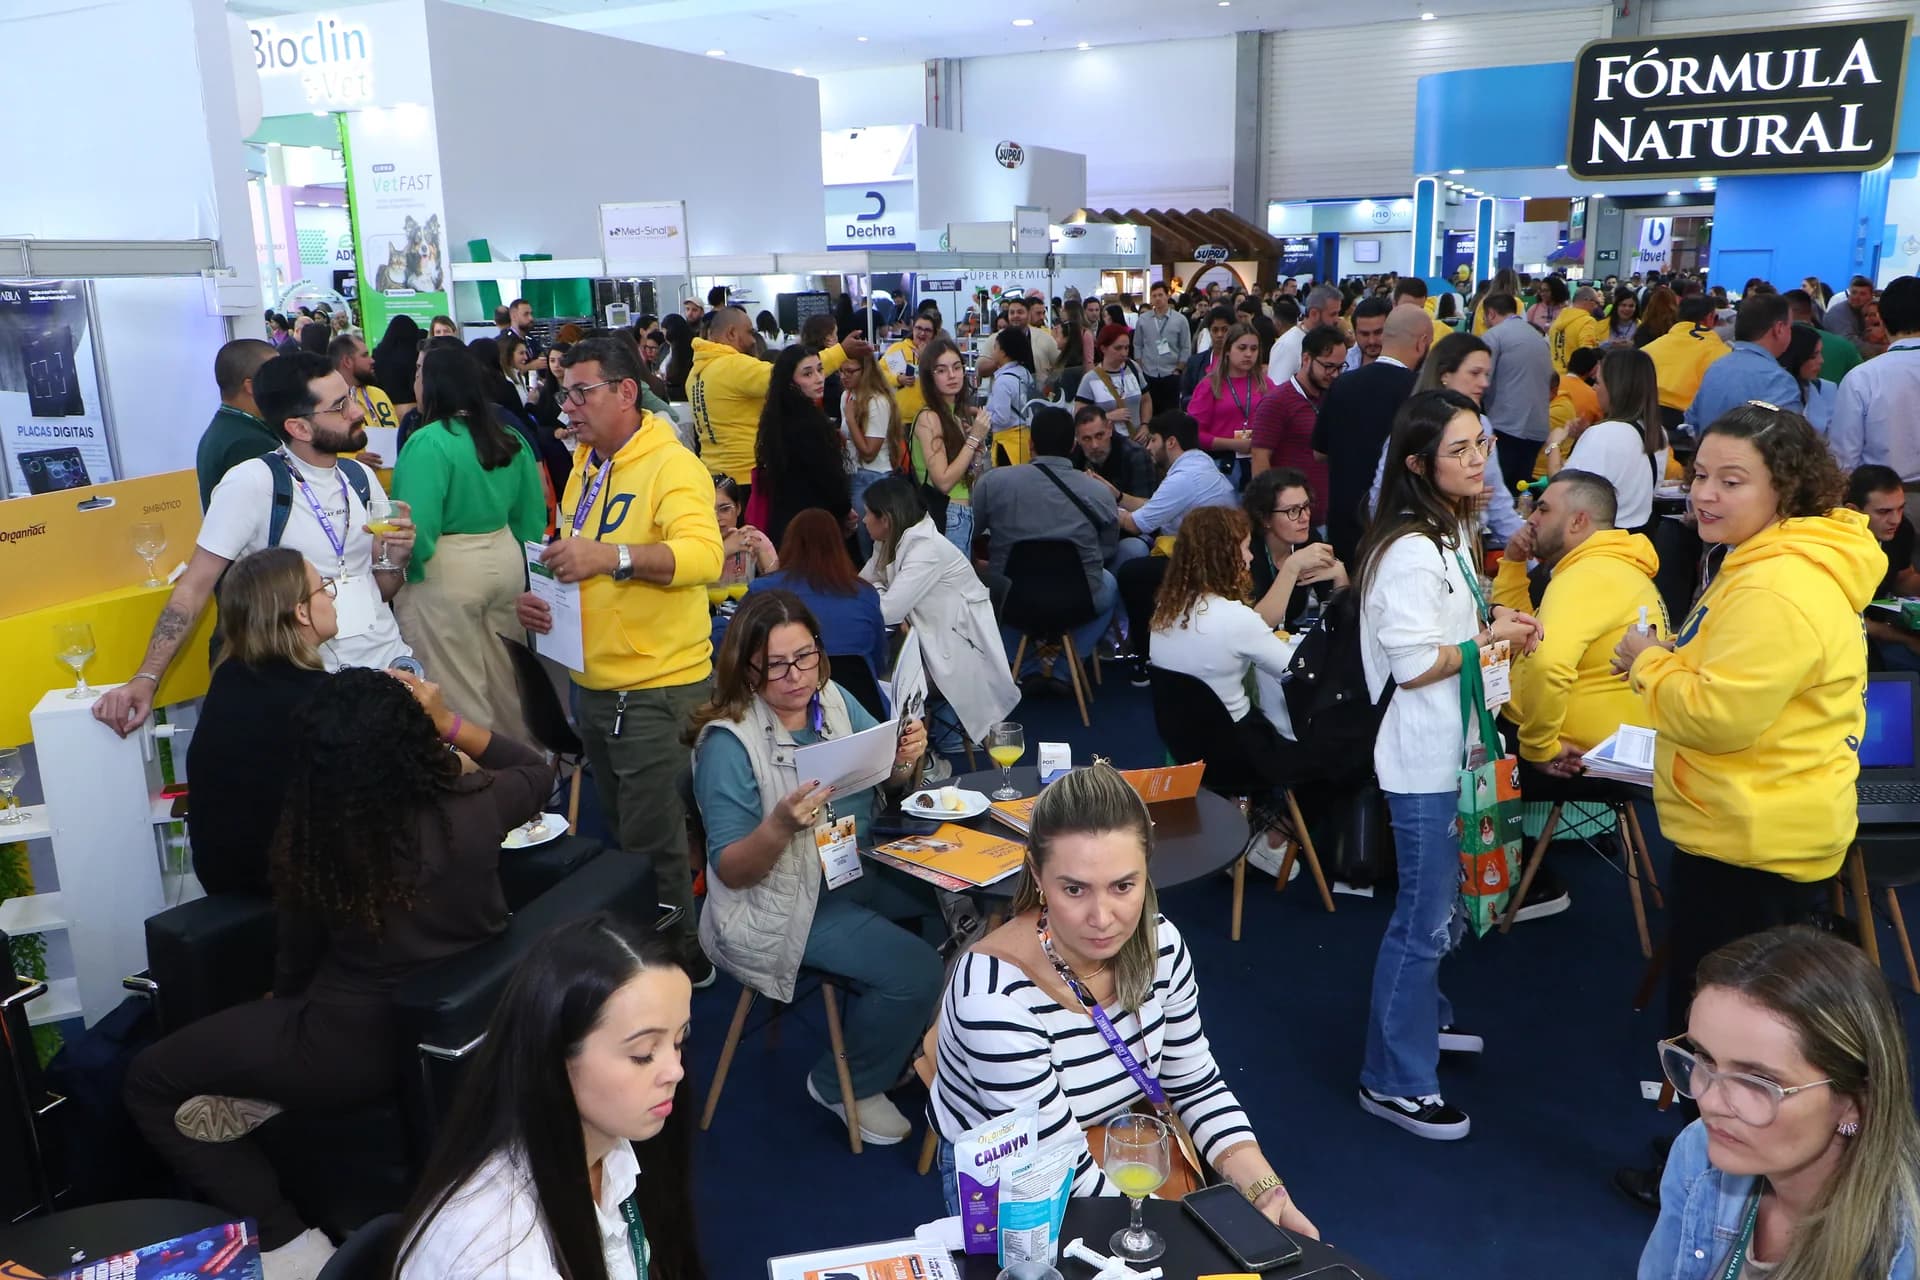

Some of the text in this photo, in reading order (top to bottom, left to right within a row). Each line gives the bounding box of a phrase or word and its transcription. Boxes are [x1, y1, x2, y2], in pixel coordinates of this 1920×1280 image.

[1593, 37, 1882, 101] FÓRMULA
[1587, 103, 1873, 164] NATURAL
[999, 148, 1022, 161] SUPRA
[846, 224, 896, 238] Dechra
[1196, 249, 1226, 259] SUPRA
[1640, 249, 1666, 262] ibvet
[964, 270, 1060, 281] SUPER PREMIUM
[17, 426, 94, 438] PLACAS DIGITAIS
[143, 500, 182, 515] SIMBIÓTICO
[0, 522, 47, 544] Organnact
[974, 1133, 1029, 1167] CALMYN
[1725, 1248, 1742, 1280] VETNIL
